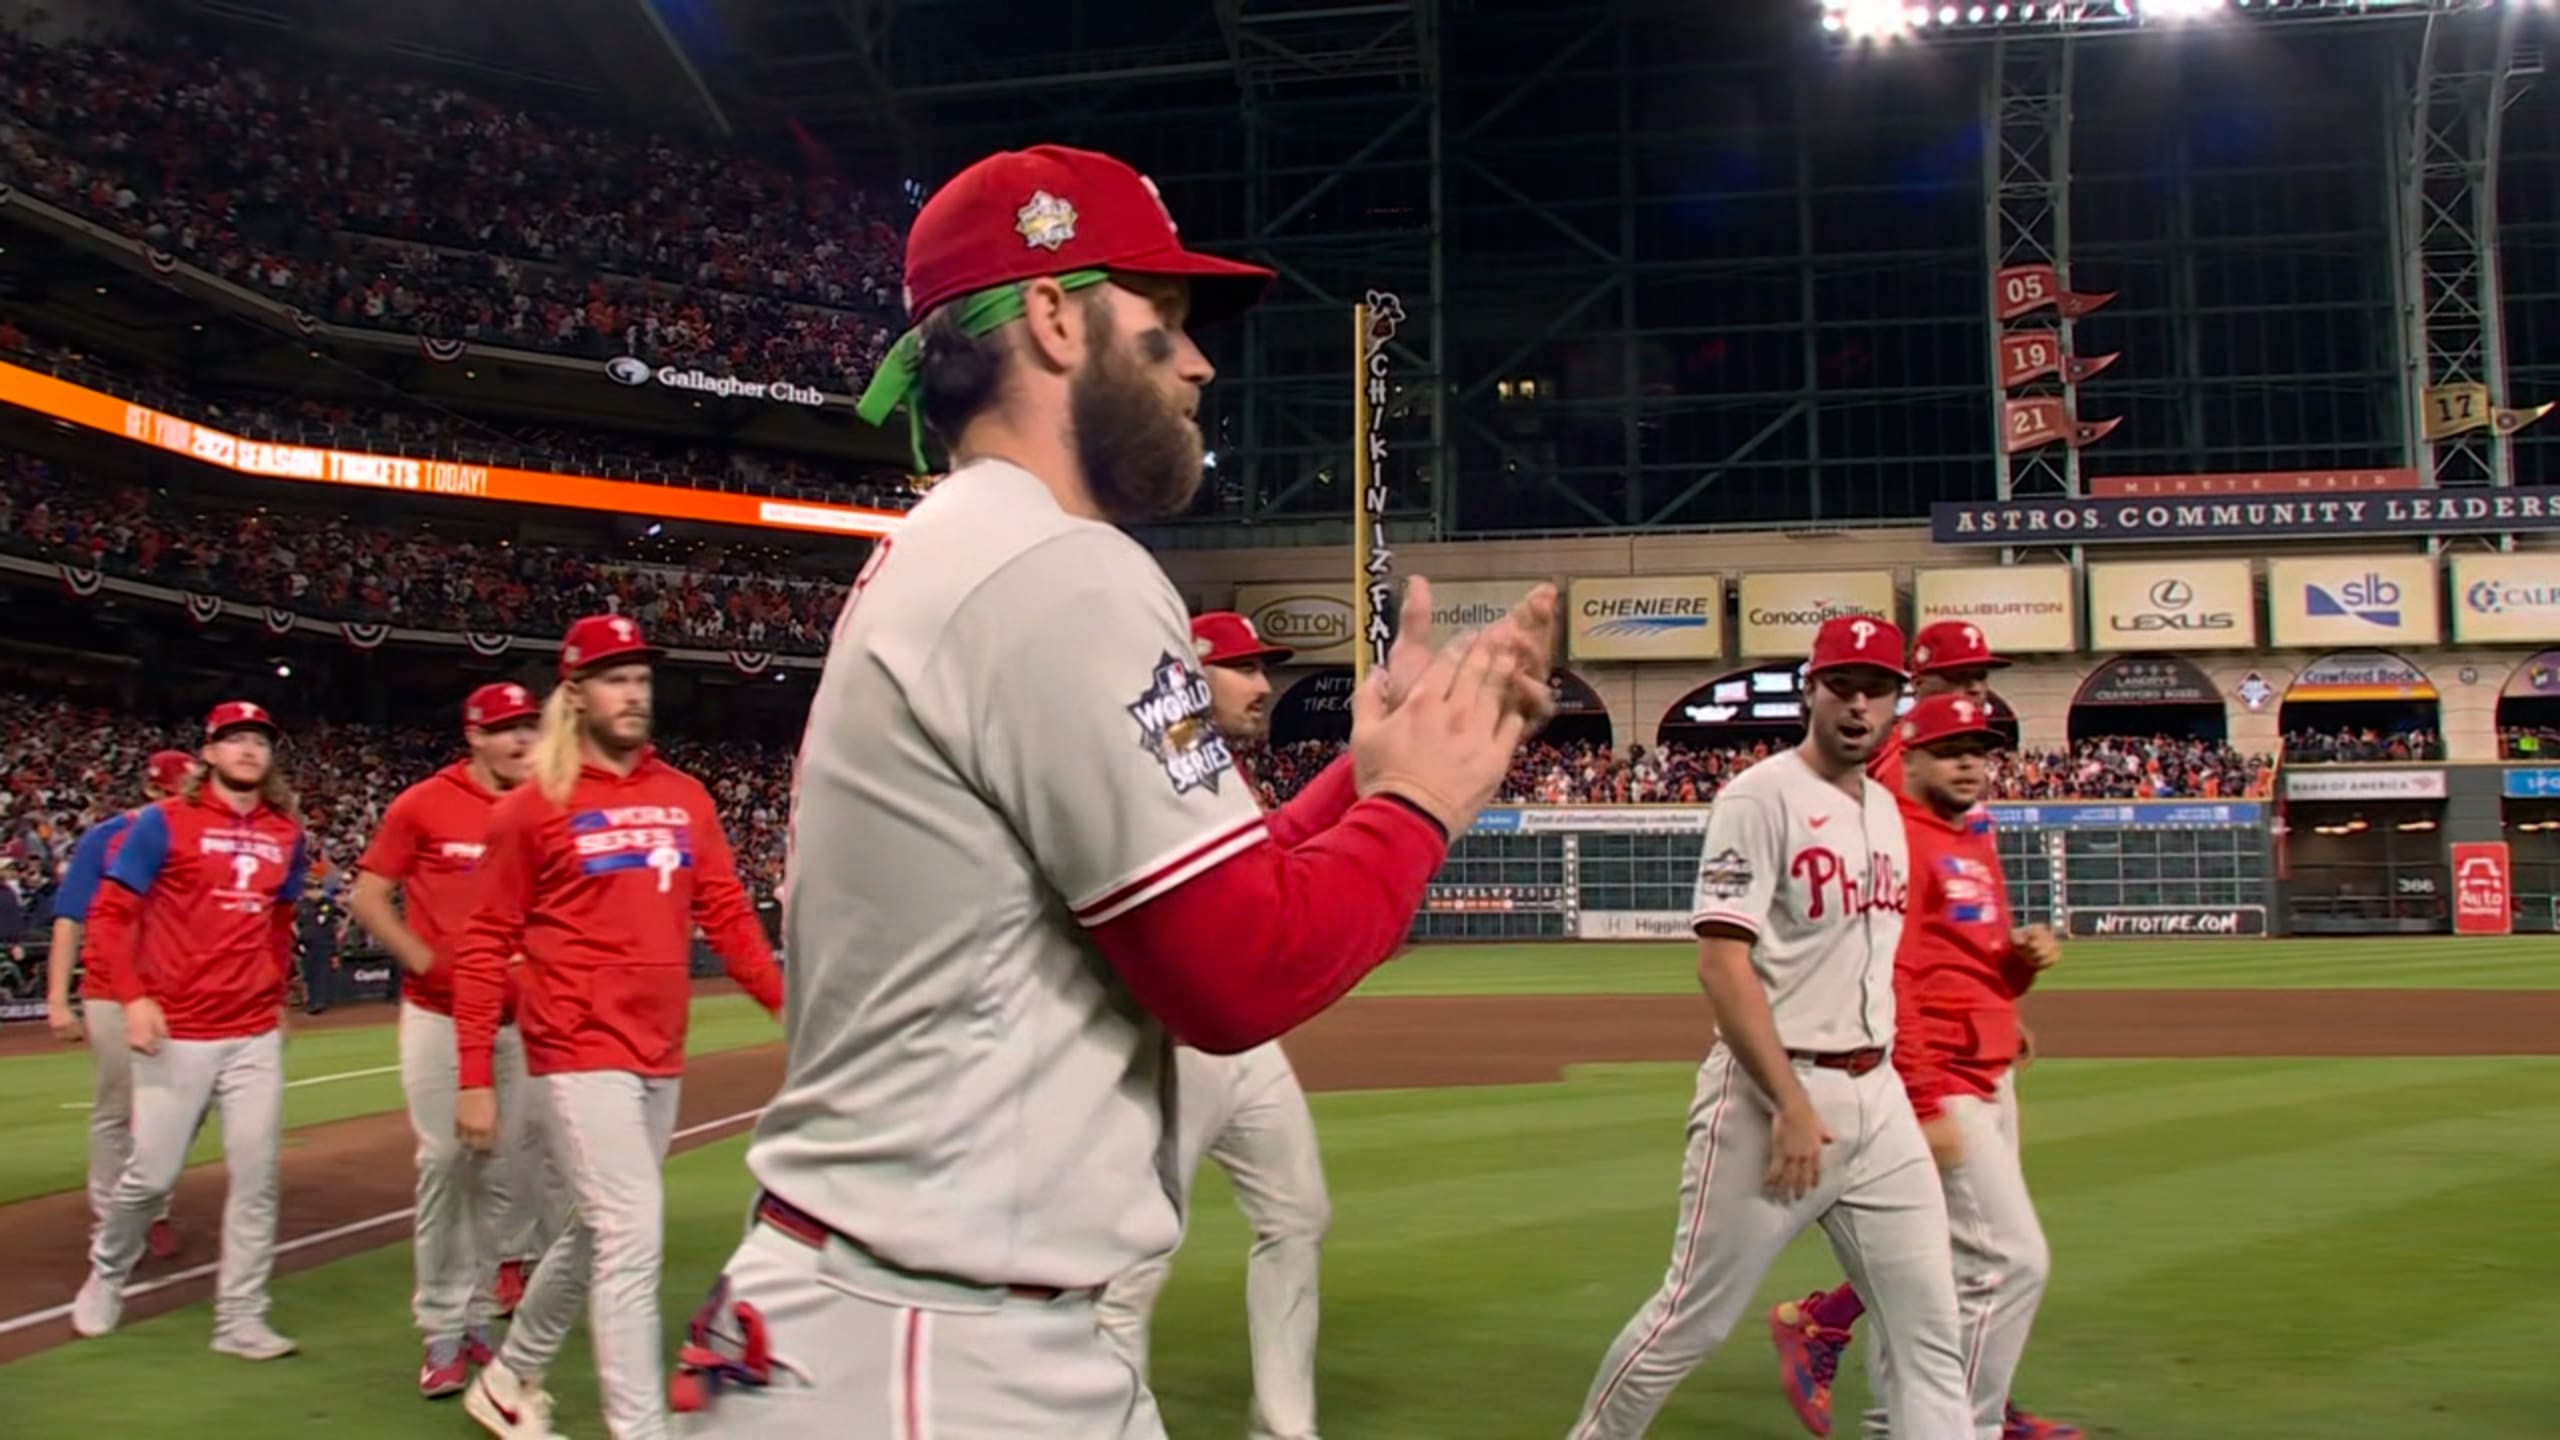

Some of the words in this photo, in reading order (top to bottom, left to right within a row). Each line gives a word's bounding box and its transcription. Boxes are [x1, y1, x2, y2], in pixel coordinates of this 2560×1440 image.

[2006, 274, 2044, 303] 05
[2012, 343, 2047, 371] 19
[657, 365, 767, 398] Gallagher
[769, 381, 825, 406] Club
[2013, 407, 2046, 434] 21
[2436, 393, 2473, 422] 17
[236, 436, 324, 480] SEASON
[327, 450, 420, 489] TICKETS
[424, 460, 488, 496] TODAY!
[2124, 478, 2262, 493] MINUTE
[2297, 475, 2386, 488] MAID
[1955, 507, 2099, 533] ASTROS
[2117, 500, 2367, 528] COMMUNITY
[2386, 494, 2560, 522] LEADERS
[2342, 573, 2399, 607] slb
[1582, 597, 1709, 617] CHENIERE
[1923, 601, 2065, 617] HALLIBURTON
[1263, 609, 1347, 637] COTTON
[2111, 613, 2234, 631] LEXUS
[1315, 677, 1355, 692] NITT
[2304, 667, 2375, 684] Crawford
[2378, 667, 2416, 682] Bock
[1132, 679, 1213, 733] WORLD
[1166, 735, 1233, 791] SERIES
[2349, 779, 2409, 790] AMERICA
[1634, 918, 1694, 935] Higgin
[2096, 911, 2239, 934] NITTOTIRE.COM
